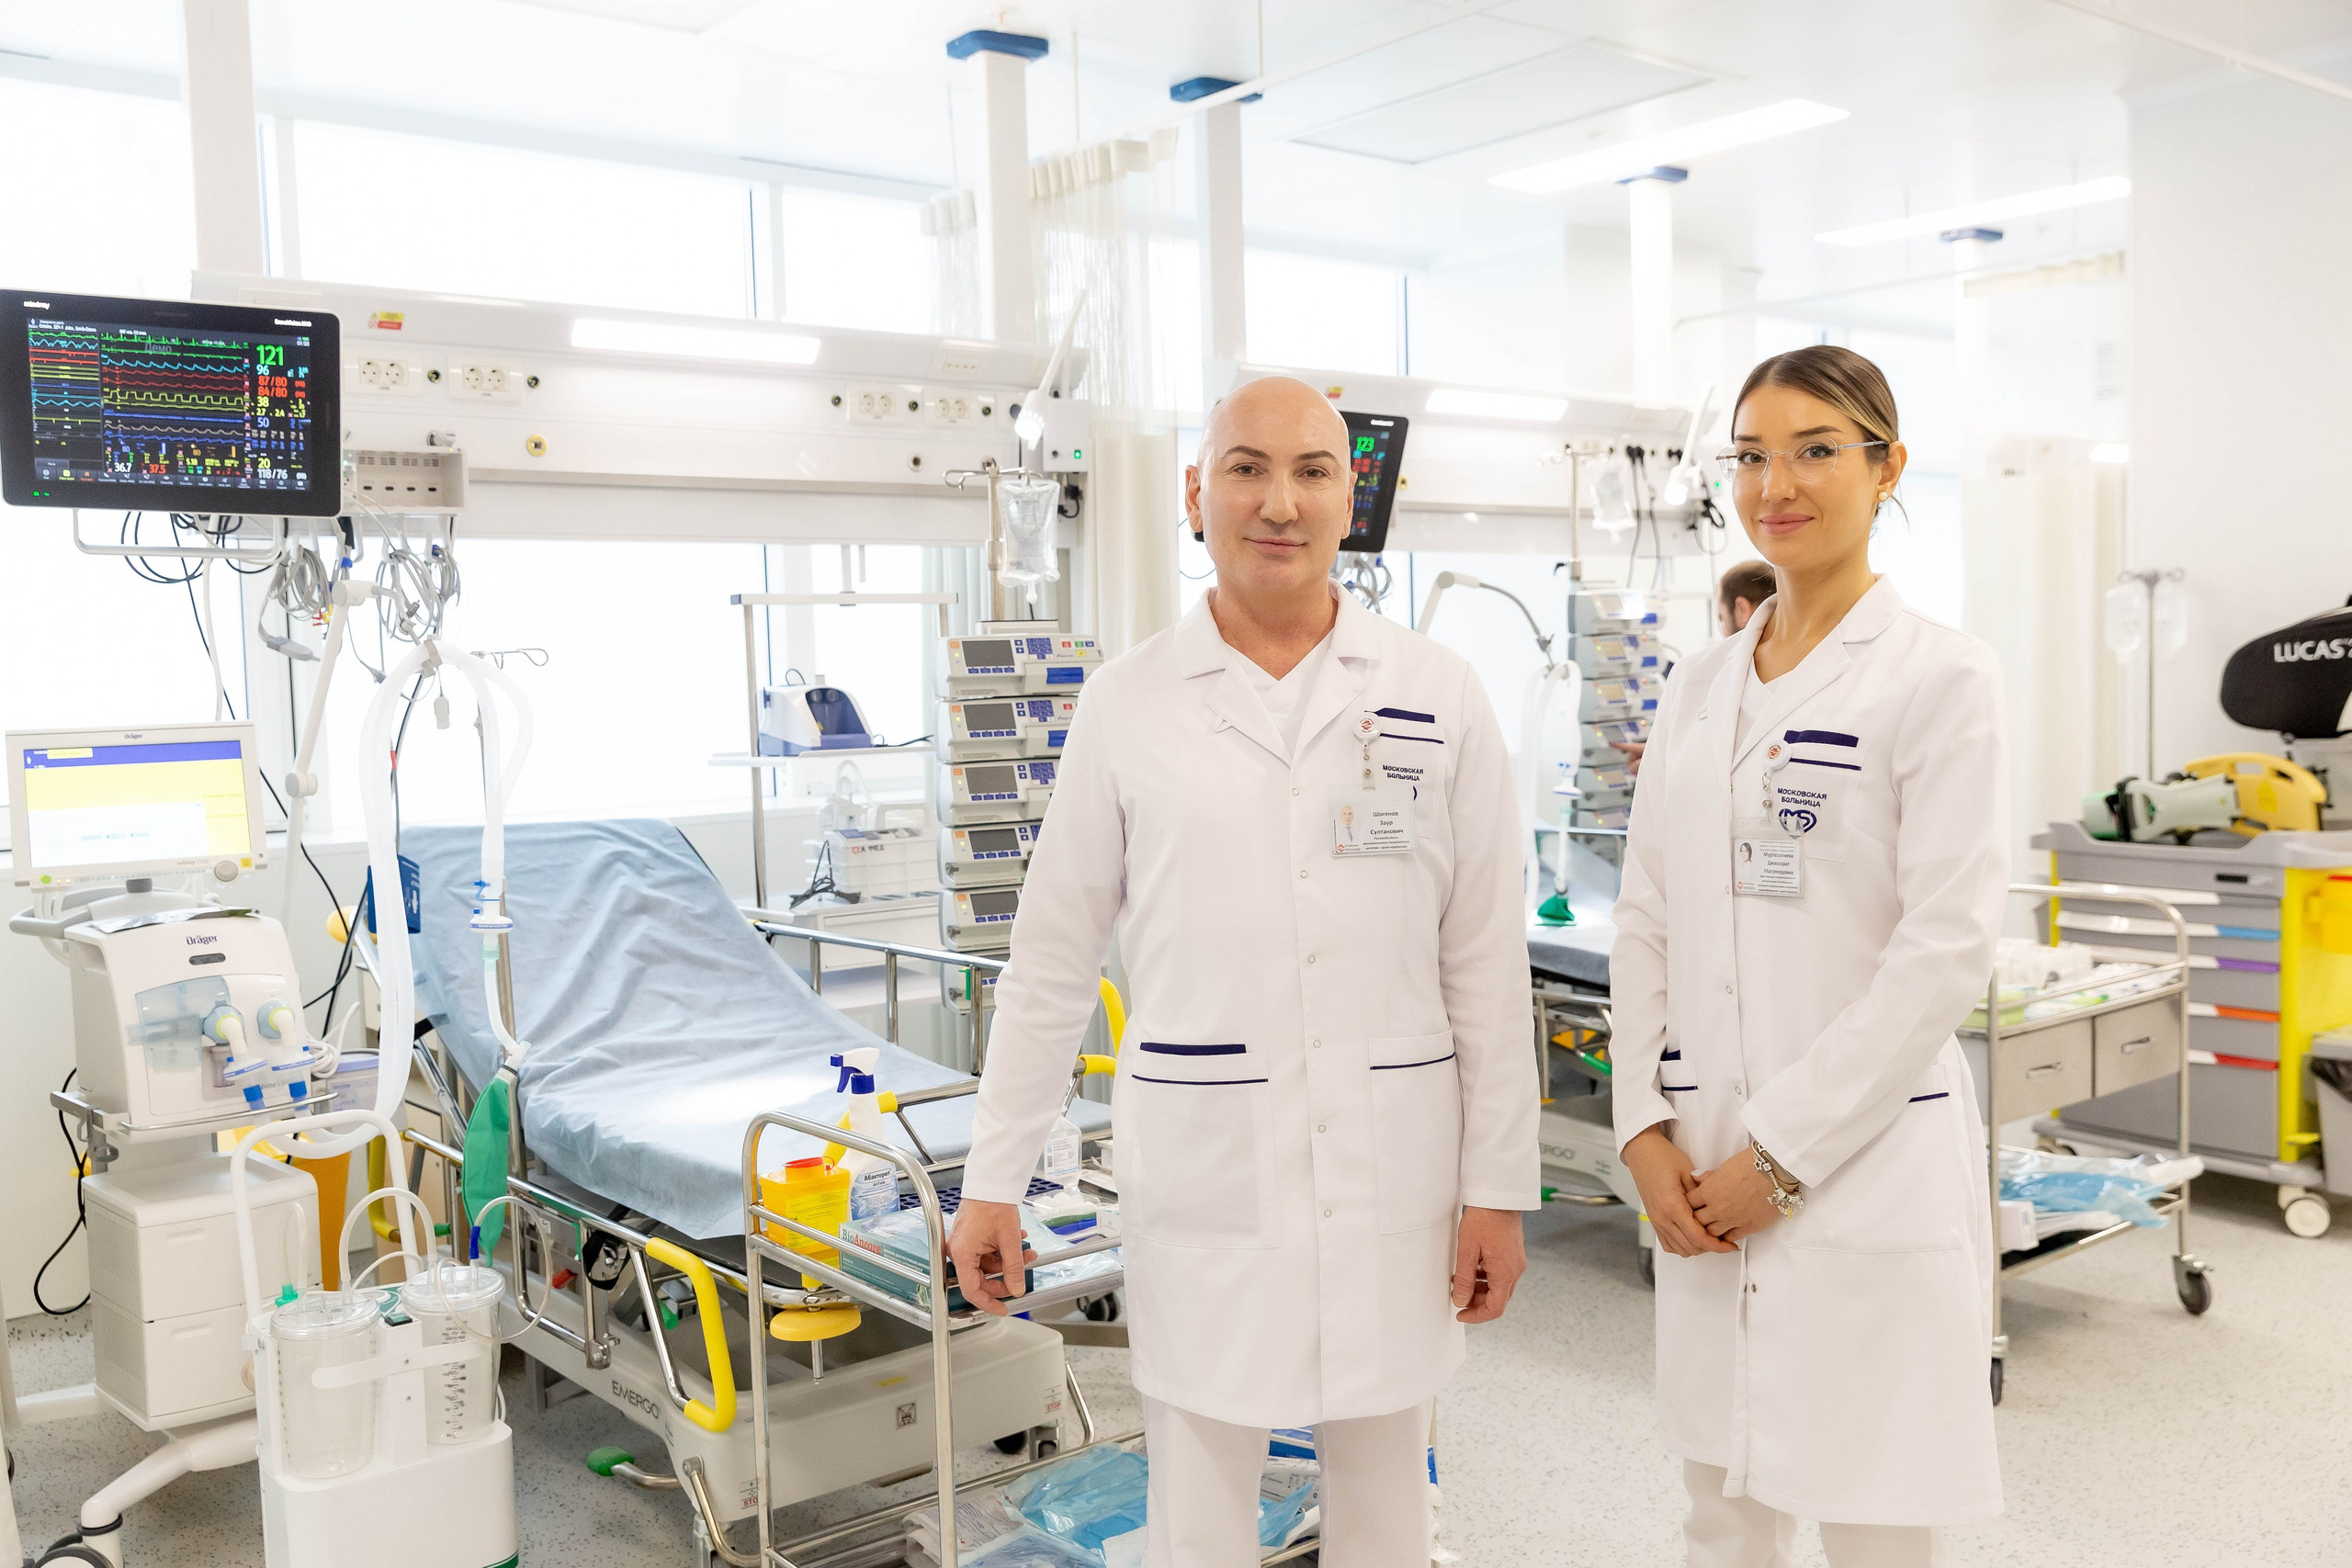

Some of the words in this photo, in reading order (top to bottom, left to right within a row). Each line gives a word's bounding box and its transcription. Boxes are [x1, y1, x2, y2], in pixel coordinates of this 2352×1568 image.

[256, 344, 283, 365] 121
[256, 364, 269, 375] 96
[257, 396, 269, 407] 38
[257, 417, 269, 427] 50
[1357, 437, 1375, 452] 123
[114, 463, 132, 472] 36.7
[258, 458, 270, 468] 20
[149, 464, 166, 474] 37.5
[2274, 638, 2345, 662] LUCAS
[1383, 765, 1424, 774] МОСКОВСКАЯ
[1387, 773, 1420, 781] БОЛЬНИЦА
[1778, 788, 1827, 800] МОСКОВСКАЯ
[1781, 796, 1820, 807] БОЛЬНИЦА
[186, 935, 217, 945] Dräger
[864, 1171, 890, 1181] Абактерил
[842, 1229, 881, 1255] BioAncore
[612, 1380, 659, 1419] EMERGO
[744, 1497, 758, 1506] STO
